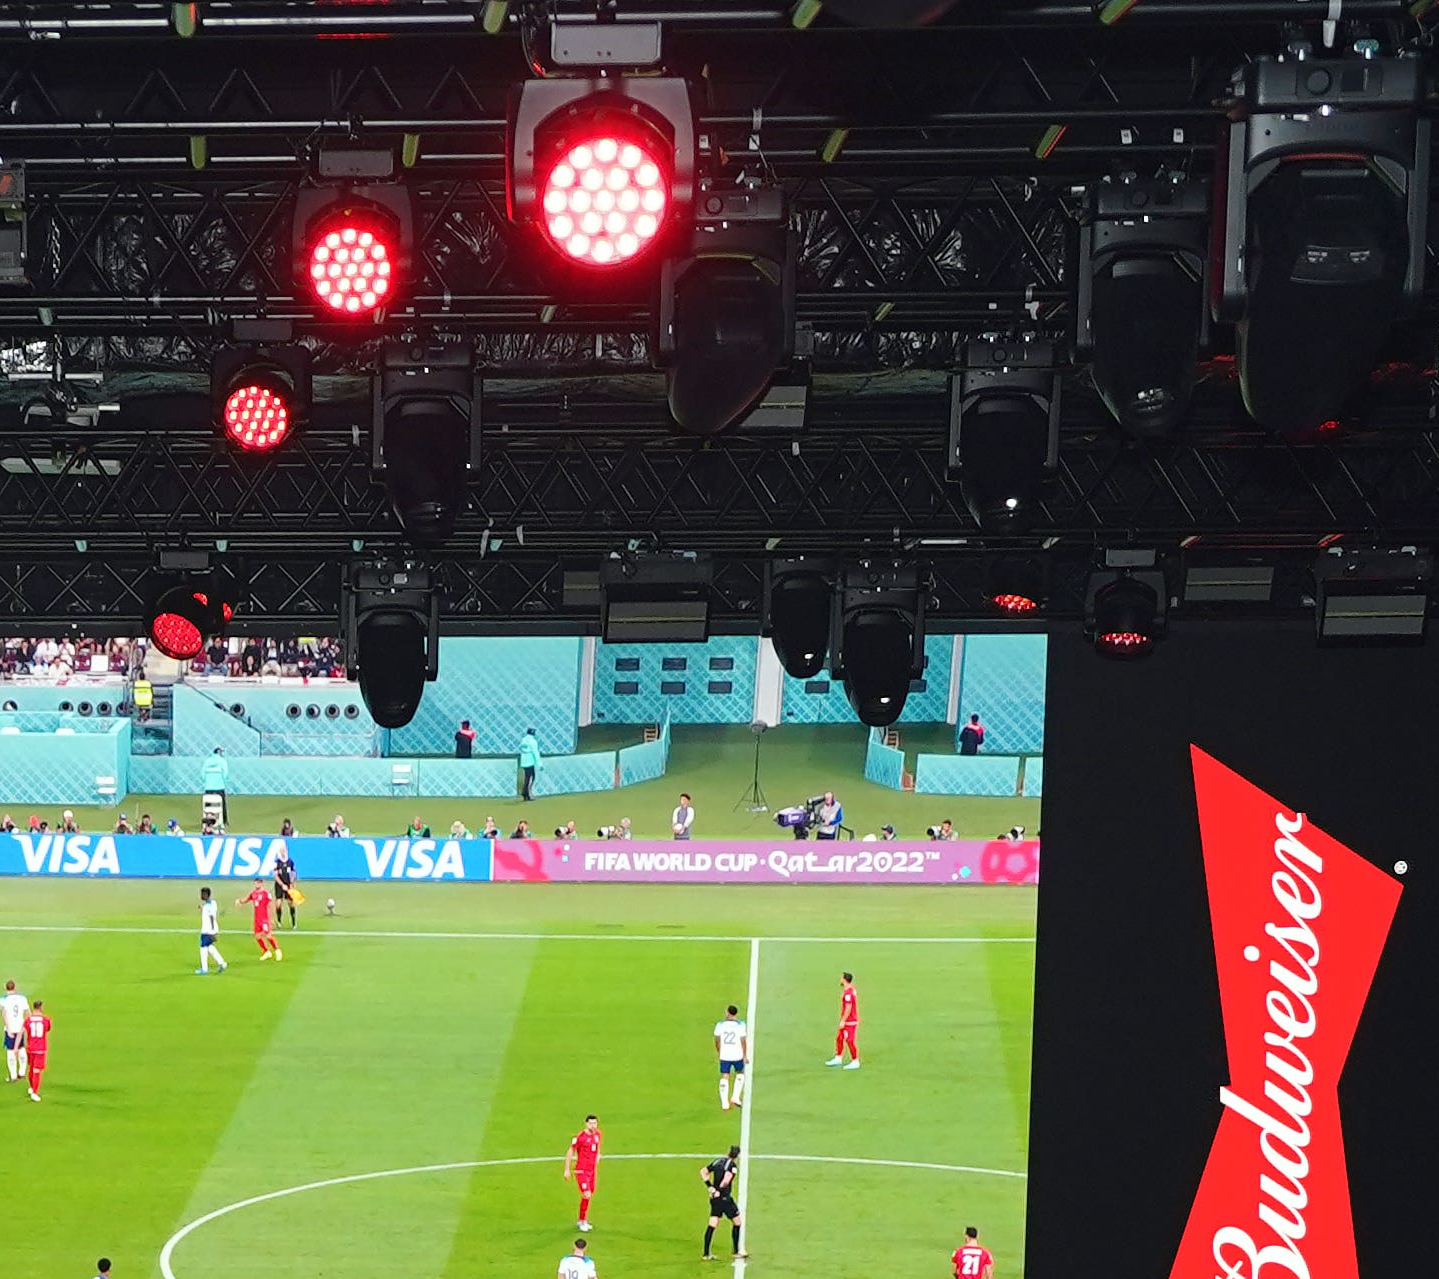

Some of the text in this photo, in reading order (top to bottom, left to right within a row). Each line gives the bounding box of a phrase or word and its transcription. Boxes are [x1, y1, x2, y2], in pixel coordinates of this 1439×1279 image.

[12, 834, 120, 874] VISA
[182, 837, 284, 877] VISA
[355, 839, 465, 879] VISA
[584, 852, 631, 871] FIFA
[632, 852, 712, 872] WORLD
[714, 852, 758, 872] CUP
[723, 1031, 736, 1045] 22
[962, 1255, 980, 1275] 21
